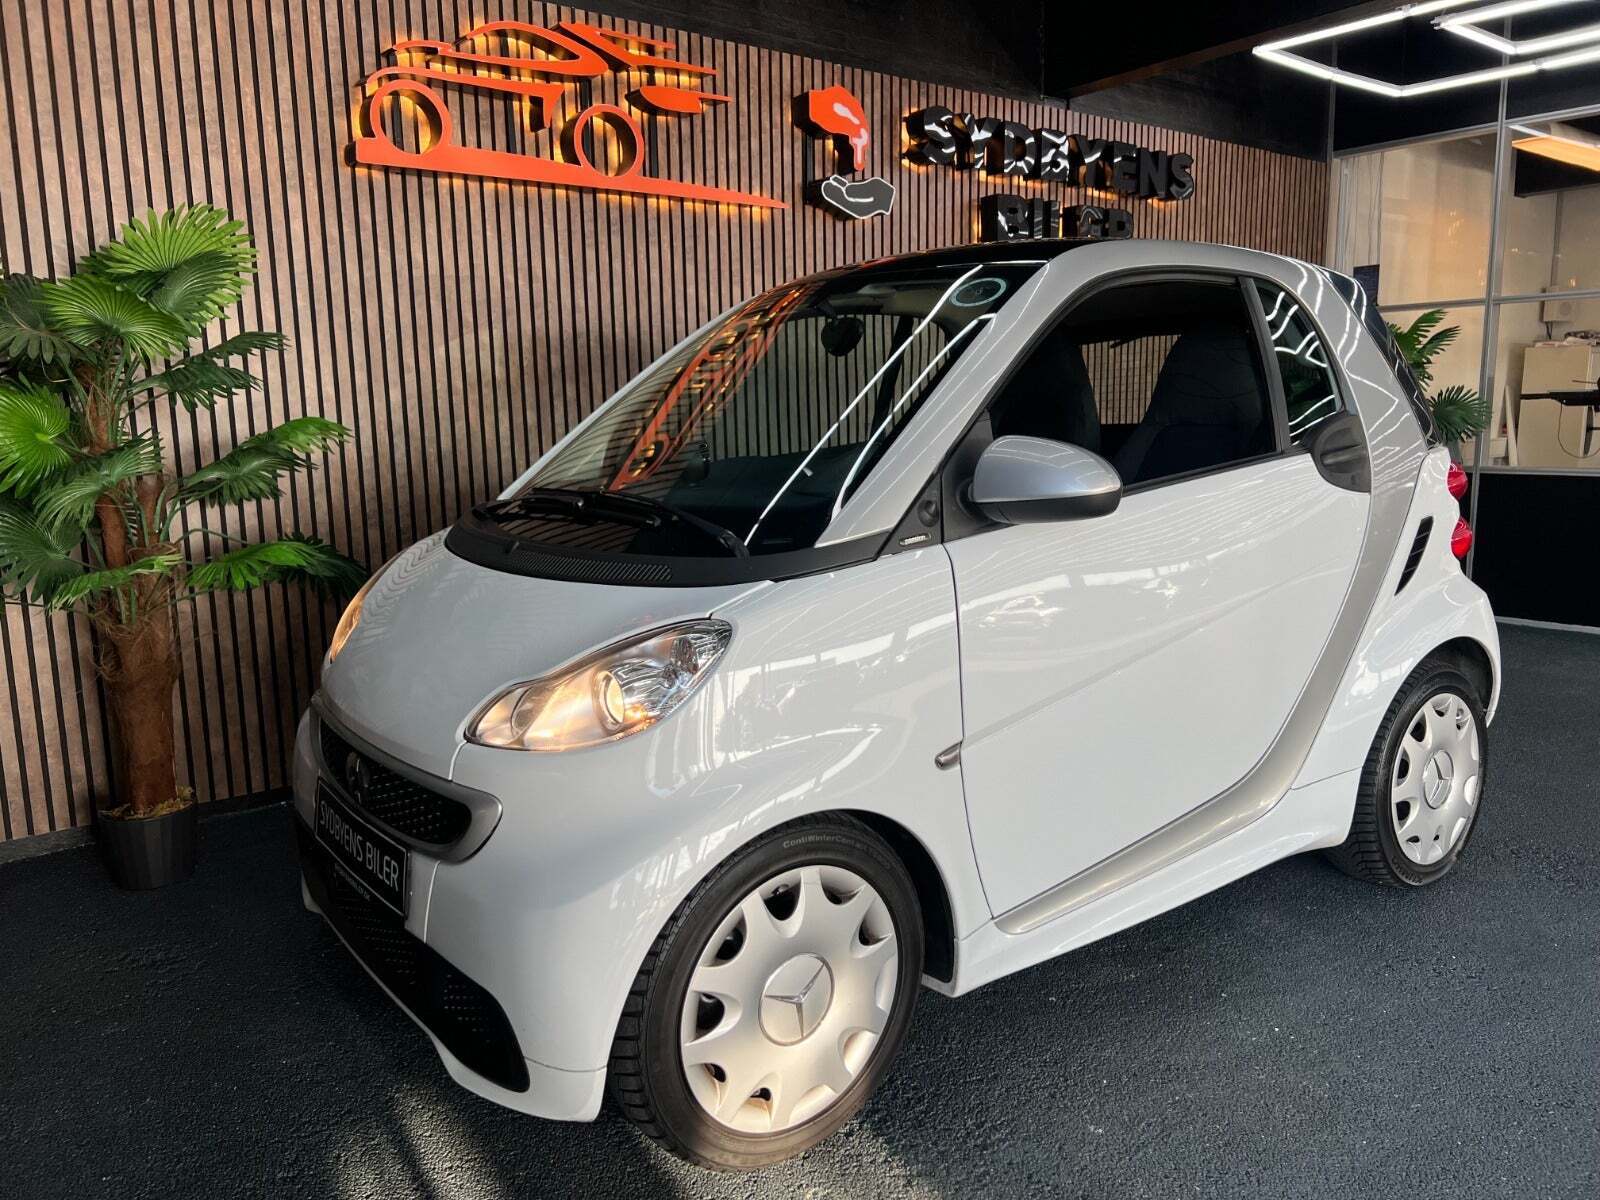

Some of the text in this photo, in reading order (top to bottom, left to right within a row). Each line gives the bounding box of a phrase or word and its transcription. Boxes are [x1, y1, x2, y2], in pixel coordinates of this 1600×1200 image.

[902, 106, 1195, 201] SYDBYENS
[320, 801, 364, 862] SYDBYENS
[365, 841, 399, 891] BILER
